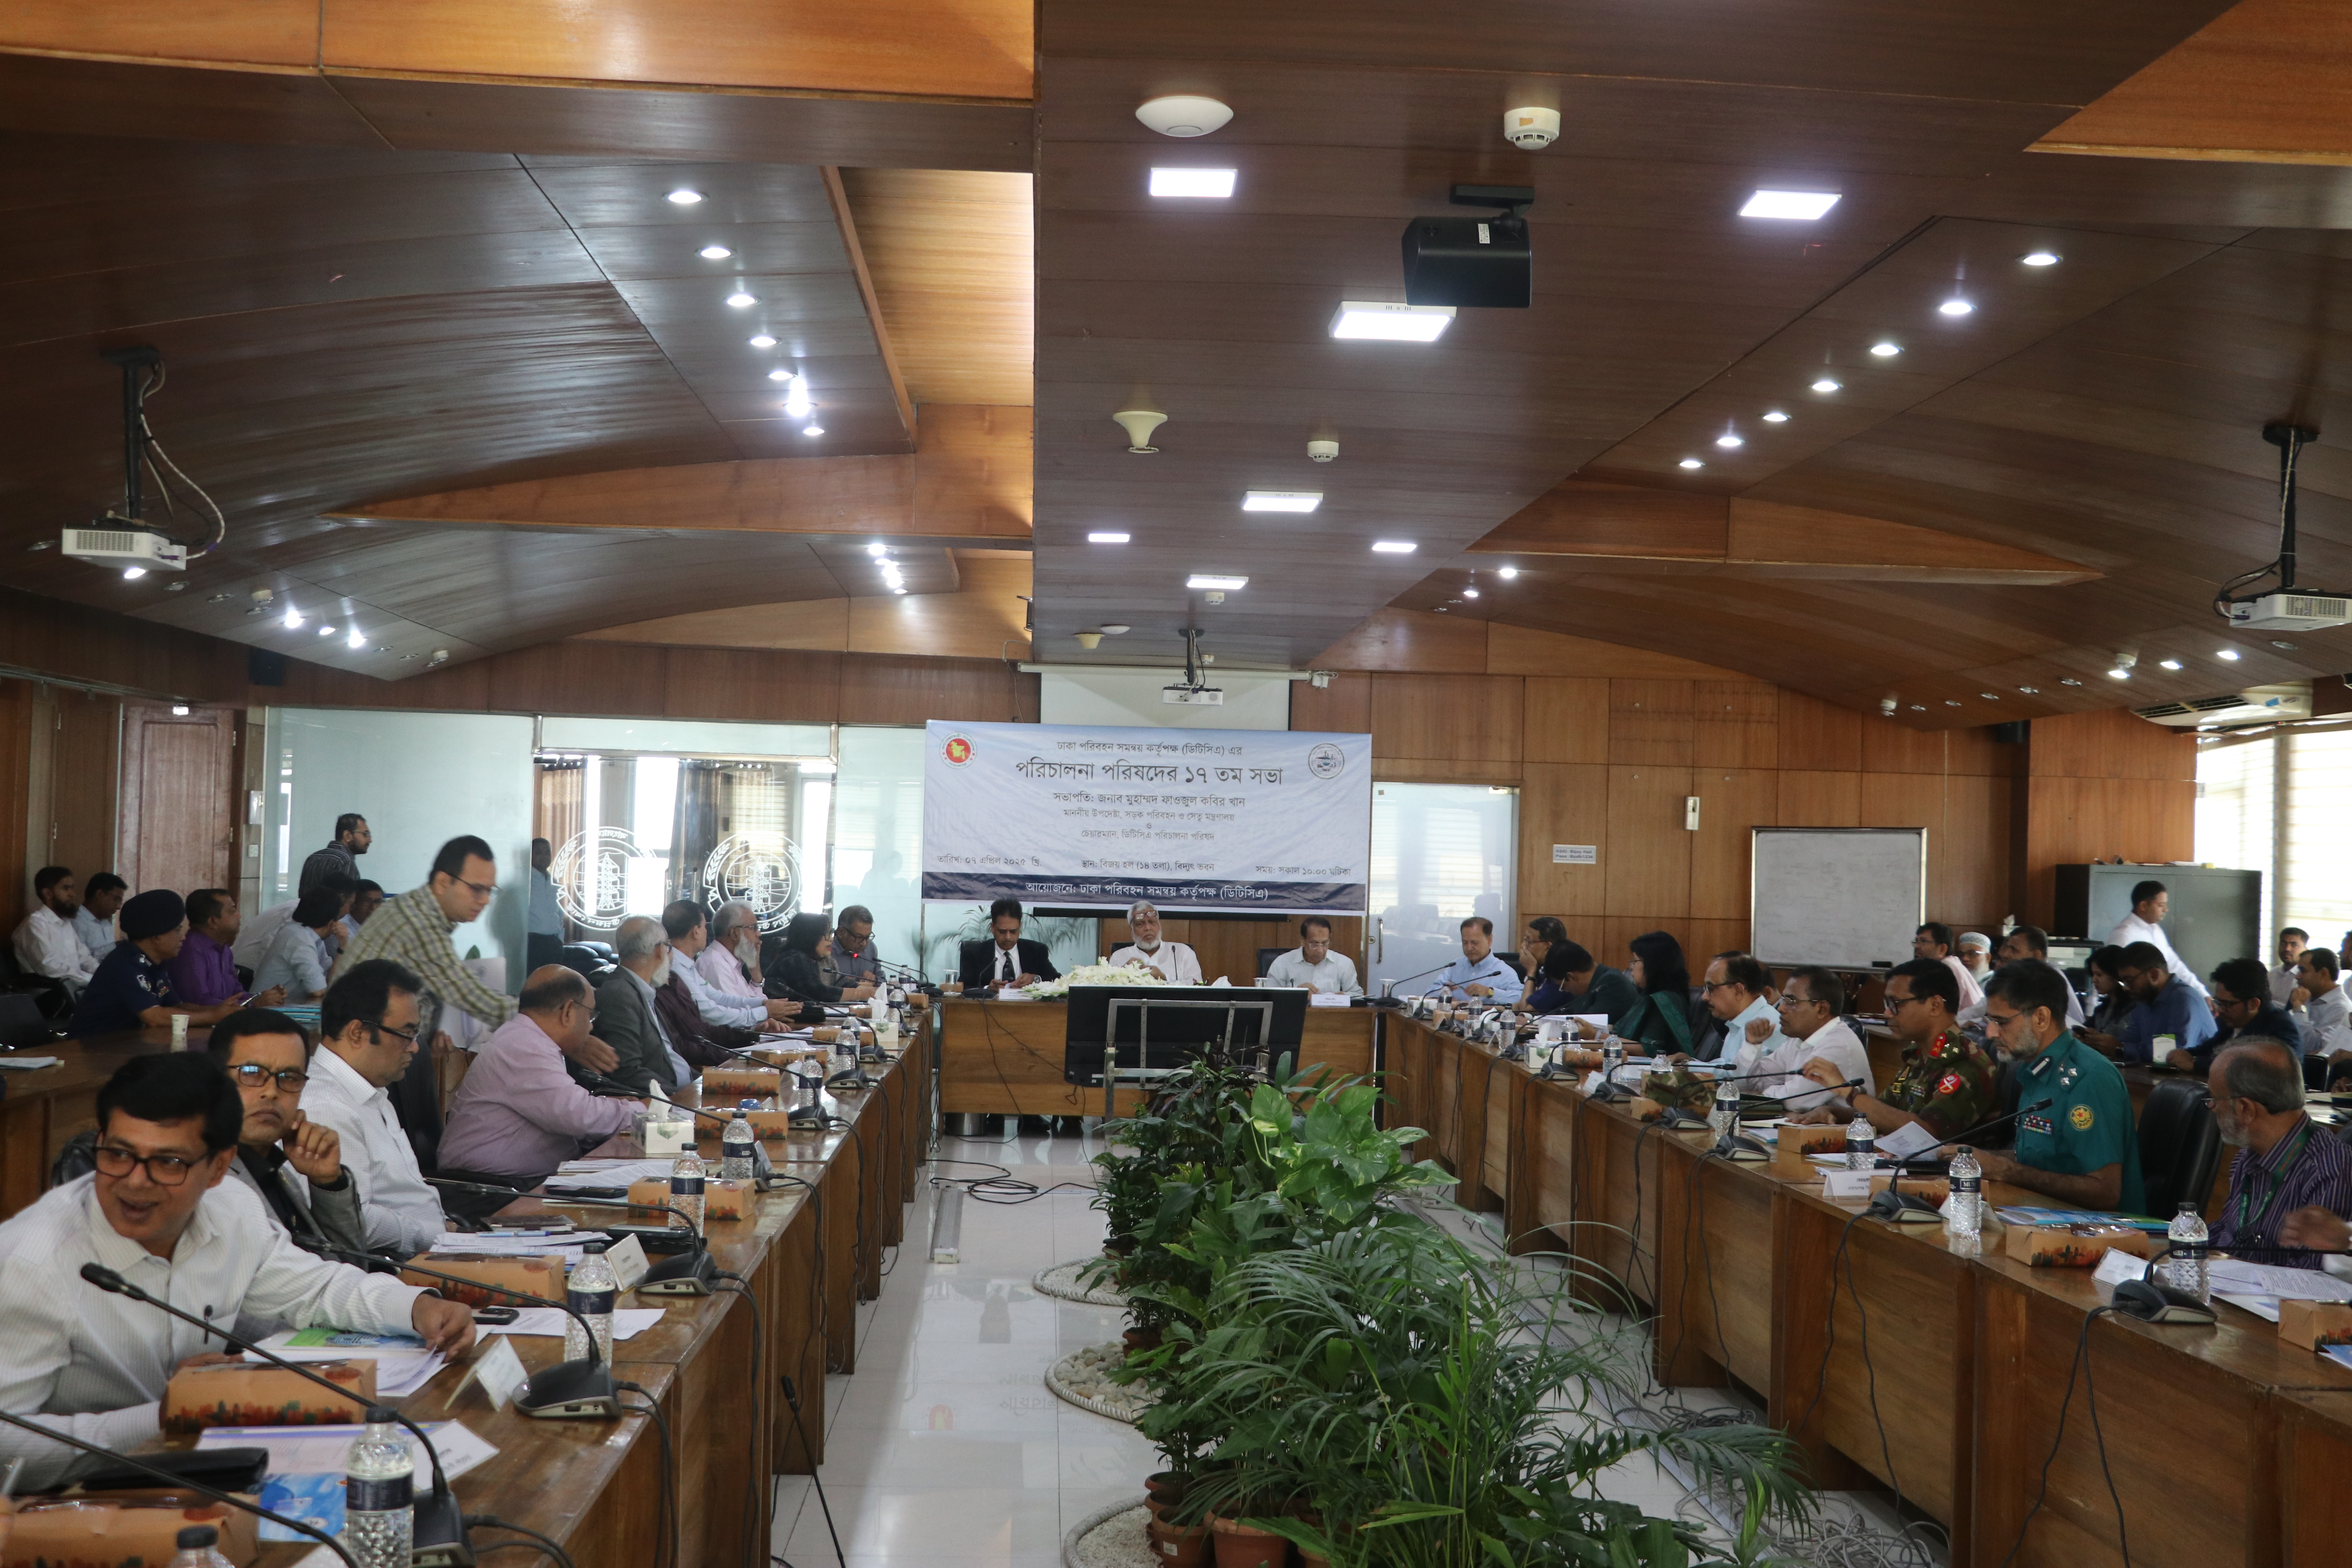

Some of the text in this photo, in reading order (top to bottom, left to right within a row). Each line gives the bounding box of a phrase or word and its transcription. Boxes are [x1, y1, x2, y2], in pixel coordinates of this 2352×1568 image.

[1056, 740, 1243, 757] ঢাকা পরিবহন সমন্বয় কর্তৃপক্ষ (ডিটিসিএ) এর
[1016, 756, 1283, 785] পরিচালনা পরিষদের ১৭ তম সভা
[1053, 790, 1245, 807] সভাপতি: জনাব মুহাম্মদ ফাওজুল কবির খান
[1063, 807, 1089, 817] মাননীয়
[1125, 811, 1144, 820] সড়ক
[1146, 809, 1176, 820] পরিবহন
[1187, 813, 1203, 822] সেতু
[1205, 813, 1234, 822] মন্ত্রণালয়
[1122, 828, 1151, 839] ডিটিসিএ
[1154, 829, 1188, 840] পরিচালনা
[1191, 831, 1215, 840] পরিষদ
[937, 853, 962, 864] তারিখ:
[979, 855, 1001, 865] এপ্রিল
[1004, 857, 1026, 866] ২০২৫
[1100, 858, 1120, 869] বিজয়
[1174, 860, 1194, 872] বিদ্যুৎ
[1197, 863, 1214, 871] ভবন
[1255, 866, 1275, 874] সময়:
[1329, 866, 1351, 876] ঘটিকা
[1025, 882, 1269, 901] আয়োজনে: ঢাকা পরিবহন সমন্বয় কর্তৃপক্ষ (ডিটিসিএ)
